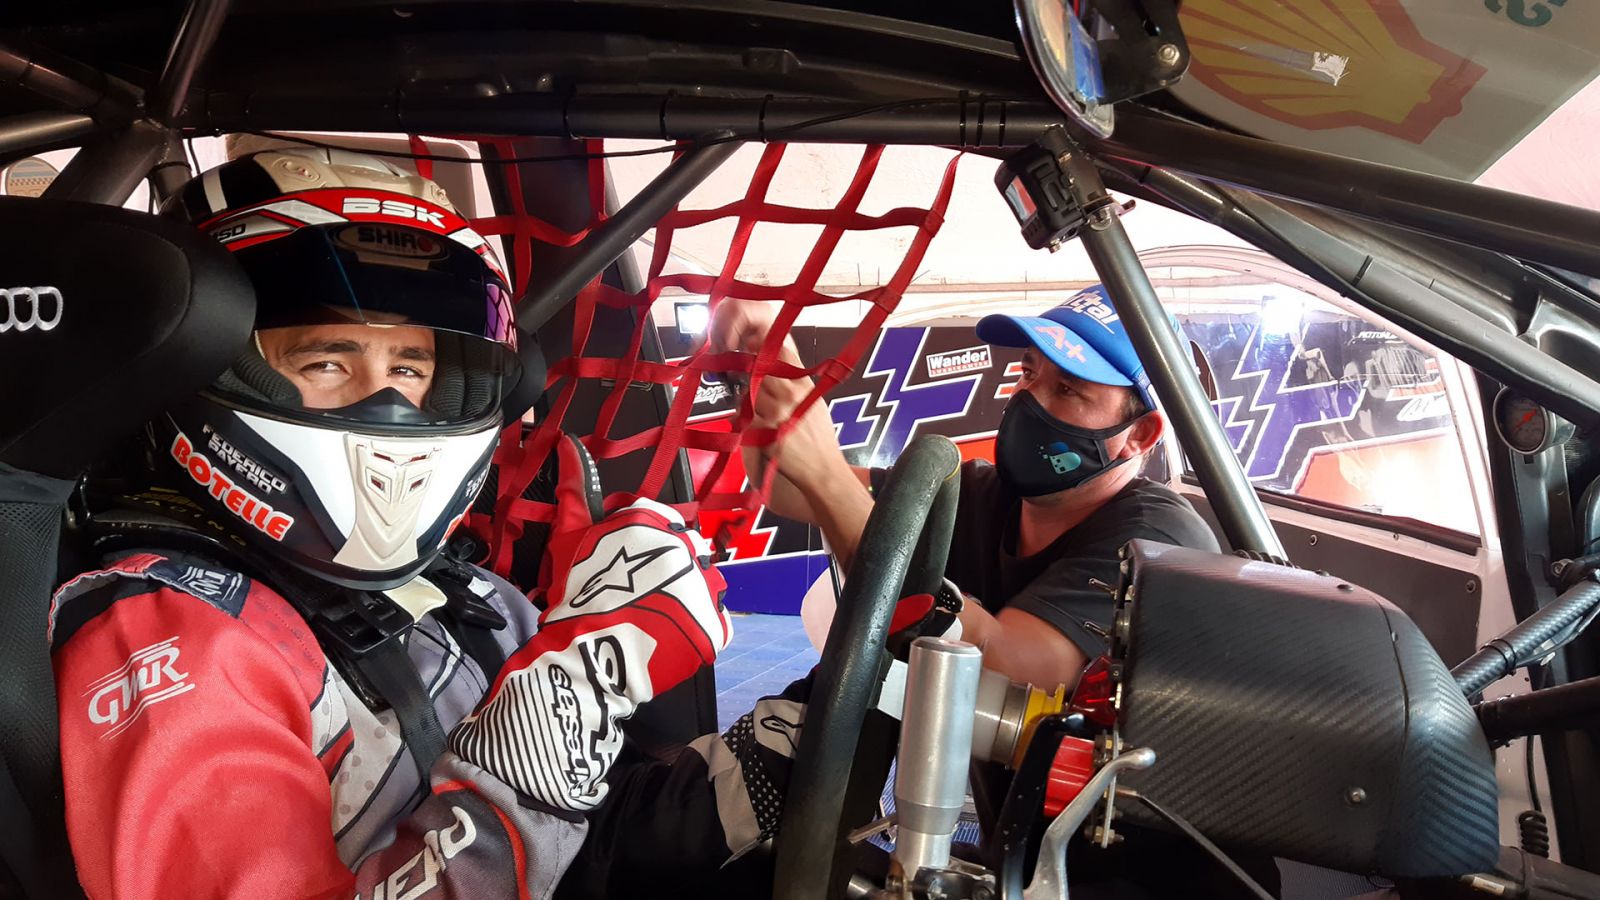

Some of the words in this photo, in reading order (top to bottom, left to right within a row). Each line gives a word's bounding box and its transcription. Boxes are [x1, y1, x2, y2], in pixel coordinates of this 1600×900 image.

[343, 197, 446, 229] BSK
[930, 350, 987, 370] Wander
[1034, 326, 1087, 363] A+
[171, 433, 293, 541] BOTELLE
